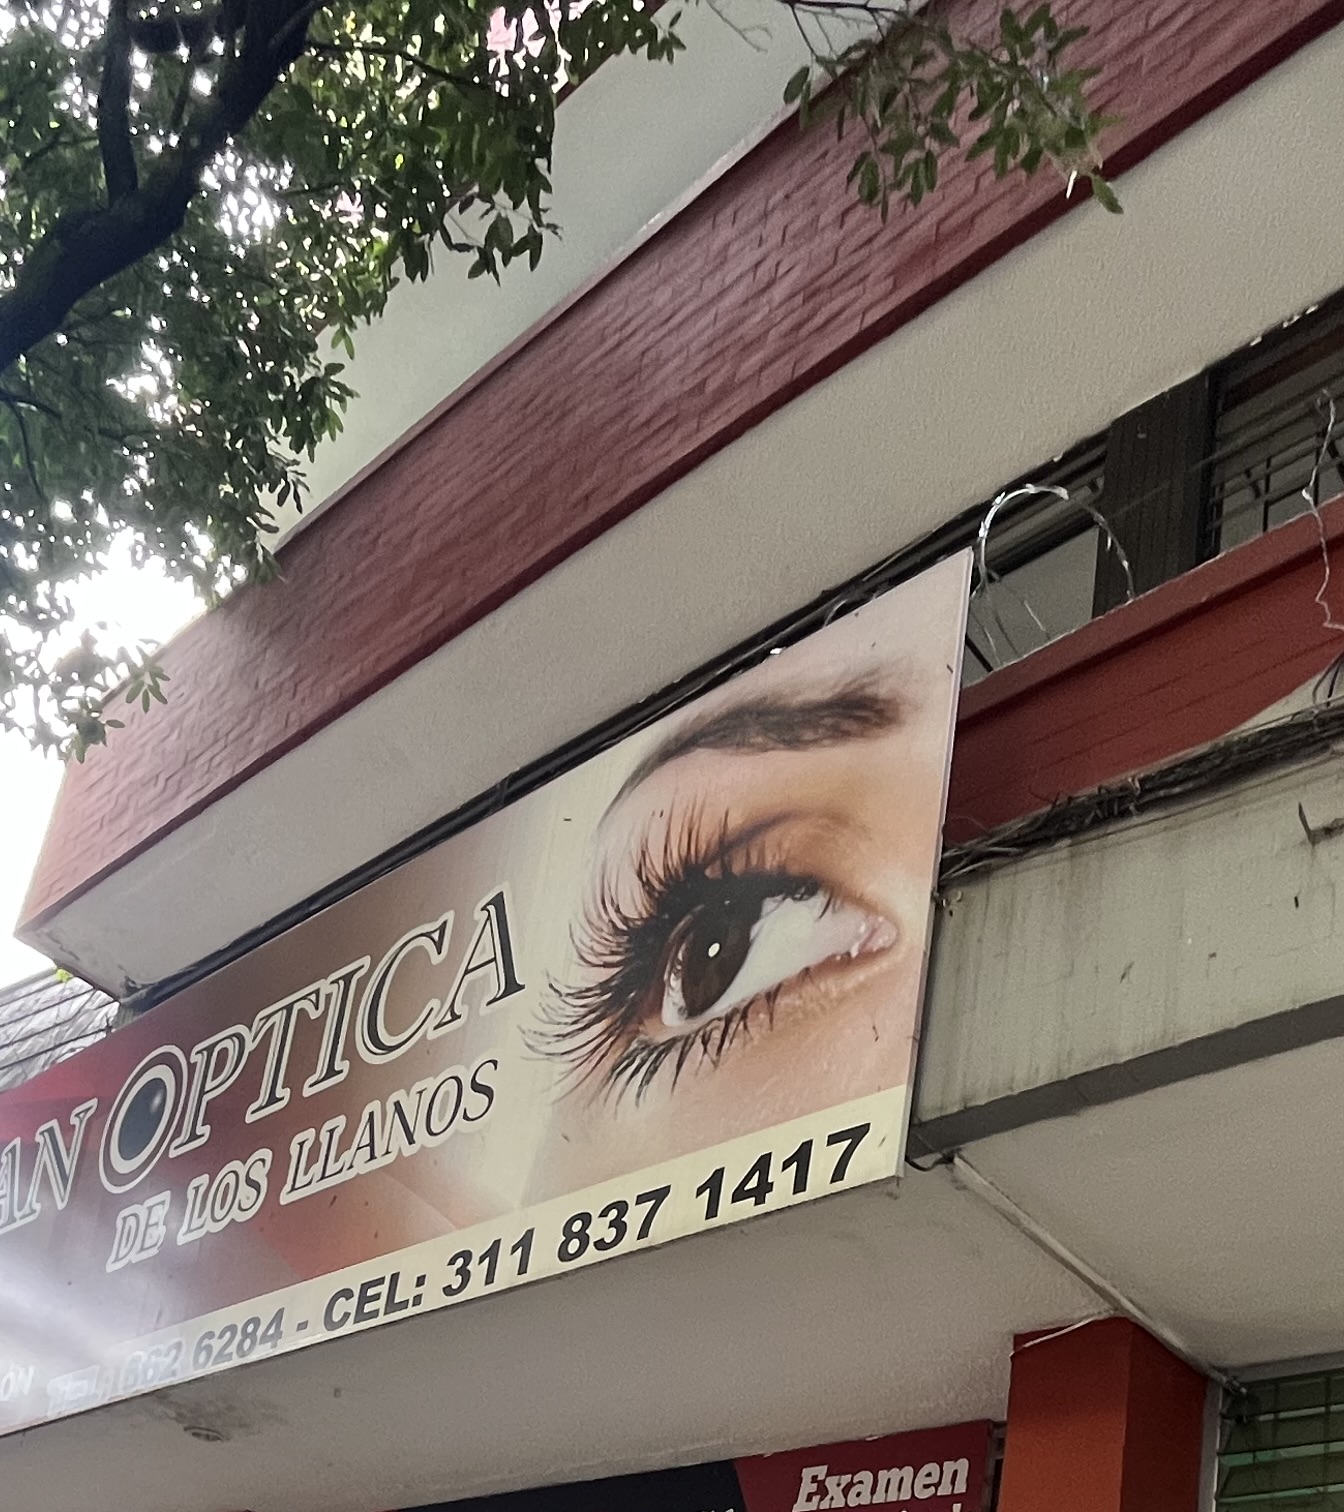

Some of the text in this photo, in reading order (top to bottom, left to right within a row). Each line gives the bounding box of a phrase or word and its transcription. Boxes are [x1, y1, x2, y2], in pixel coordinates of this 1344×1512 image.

[99, 882, 529, 1194] OPTICA
[106, 1058, 500, 1273] DE LOS LLANOS
[192, 1307, 285, 1371] 6284
[323, 1270, 427, 1332] CEL:
[442, 1226, 537, 1297] 311
[557, 1185, 672, 1263] 837
[695, 1122, 872, 1221] 1417
[792, 1457, 971, 1512] Examen
